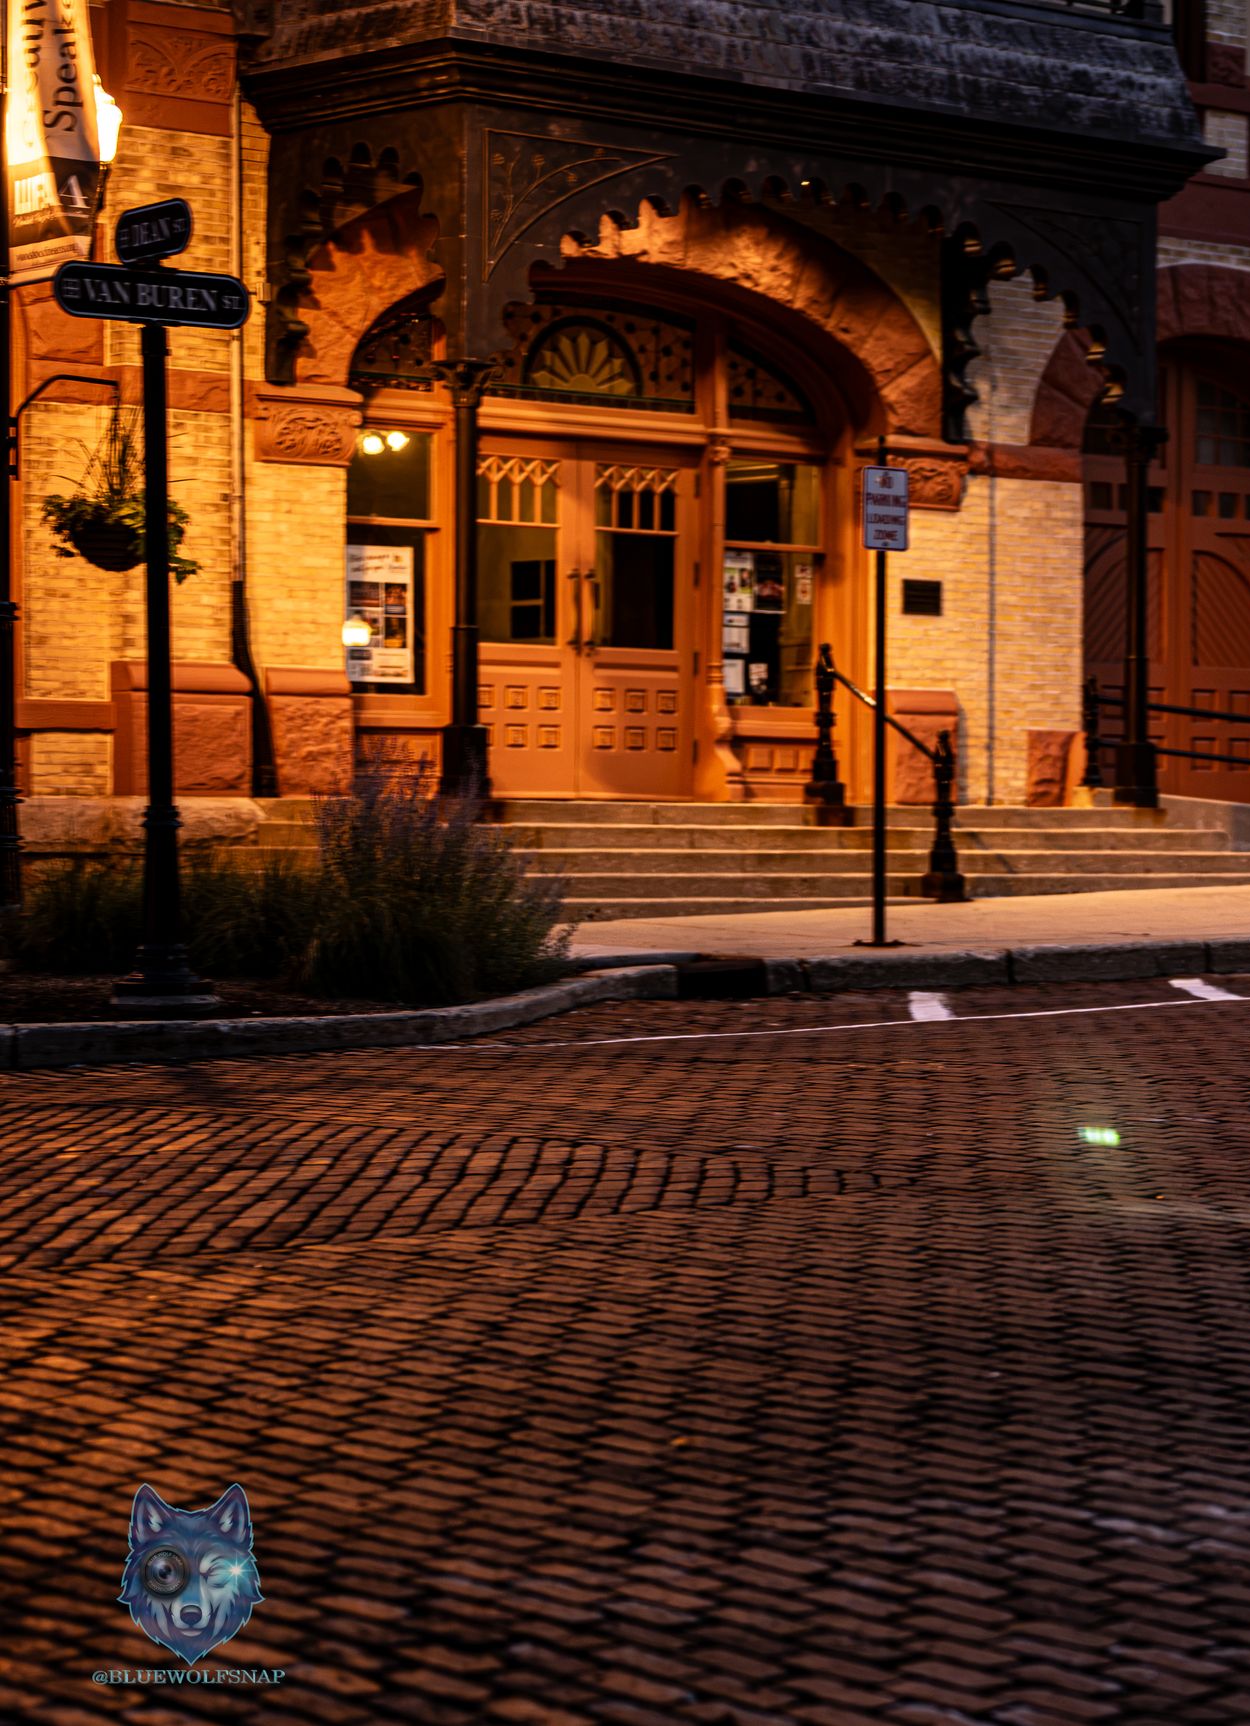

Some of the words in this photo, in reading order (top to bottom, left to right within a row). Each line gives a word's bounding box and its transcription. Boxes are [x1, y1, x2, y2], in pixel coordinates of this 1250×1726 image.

[129, 217, 172, 247] DEAN
[83, 277, 132, 305] VAN
[134, 281, 219, 312] BUREN
